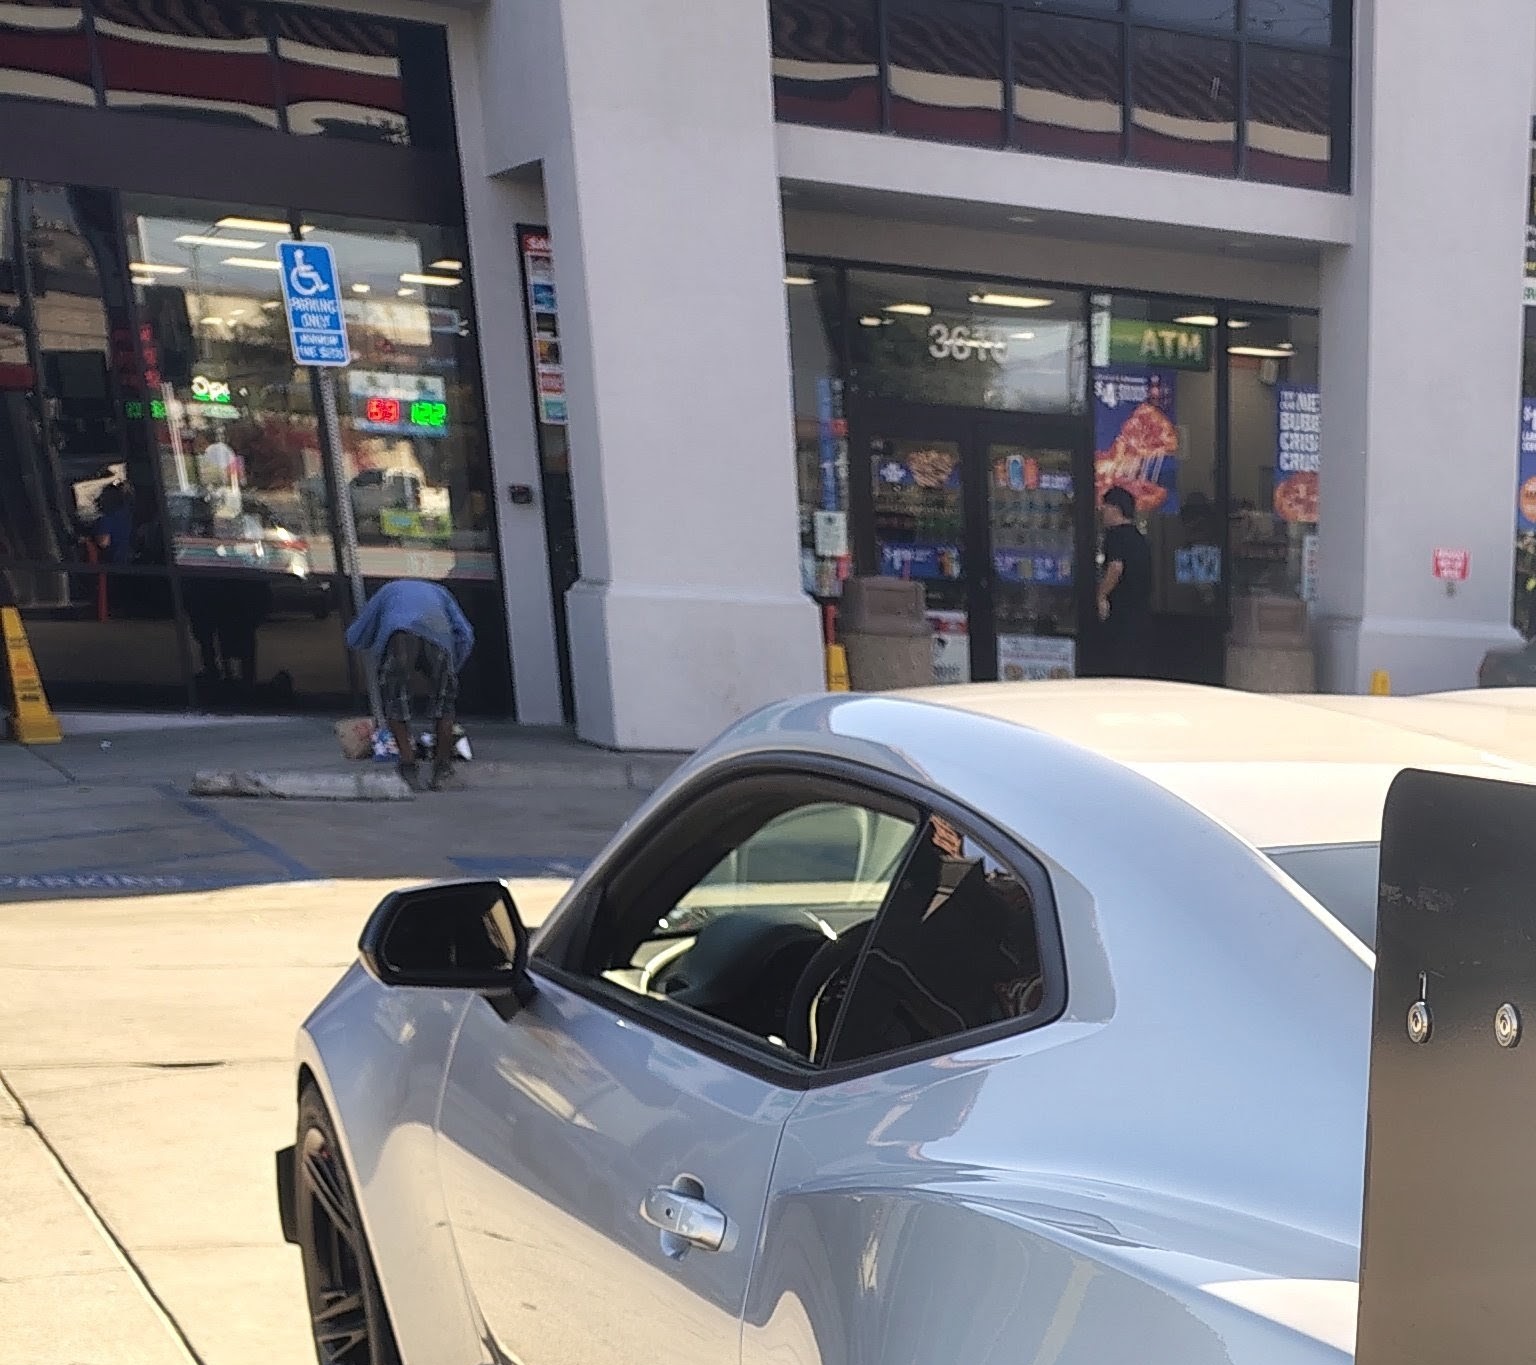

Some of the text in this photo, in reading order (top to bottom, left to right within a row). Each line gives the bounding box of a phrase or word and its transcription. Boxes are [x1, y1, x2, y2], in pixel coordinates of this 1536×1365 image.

[287, 296, 338, 314] PARKING
[300, 313, 331, 328] ONLY
[1140, 328, 1203, 361] ATM
